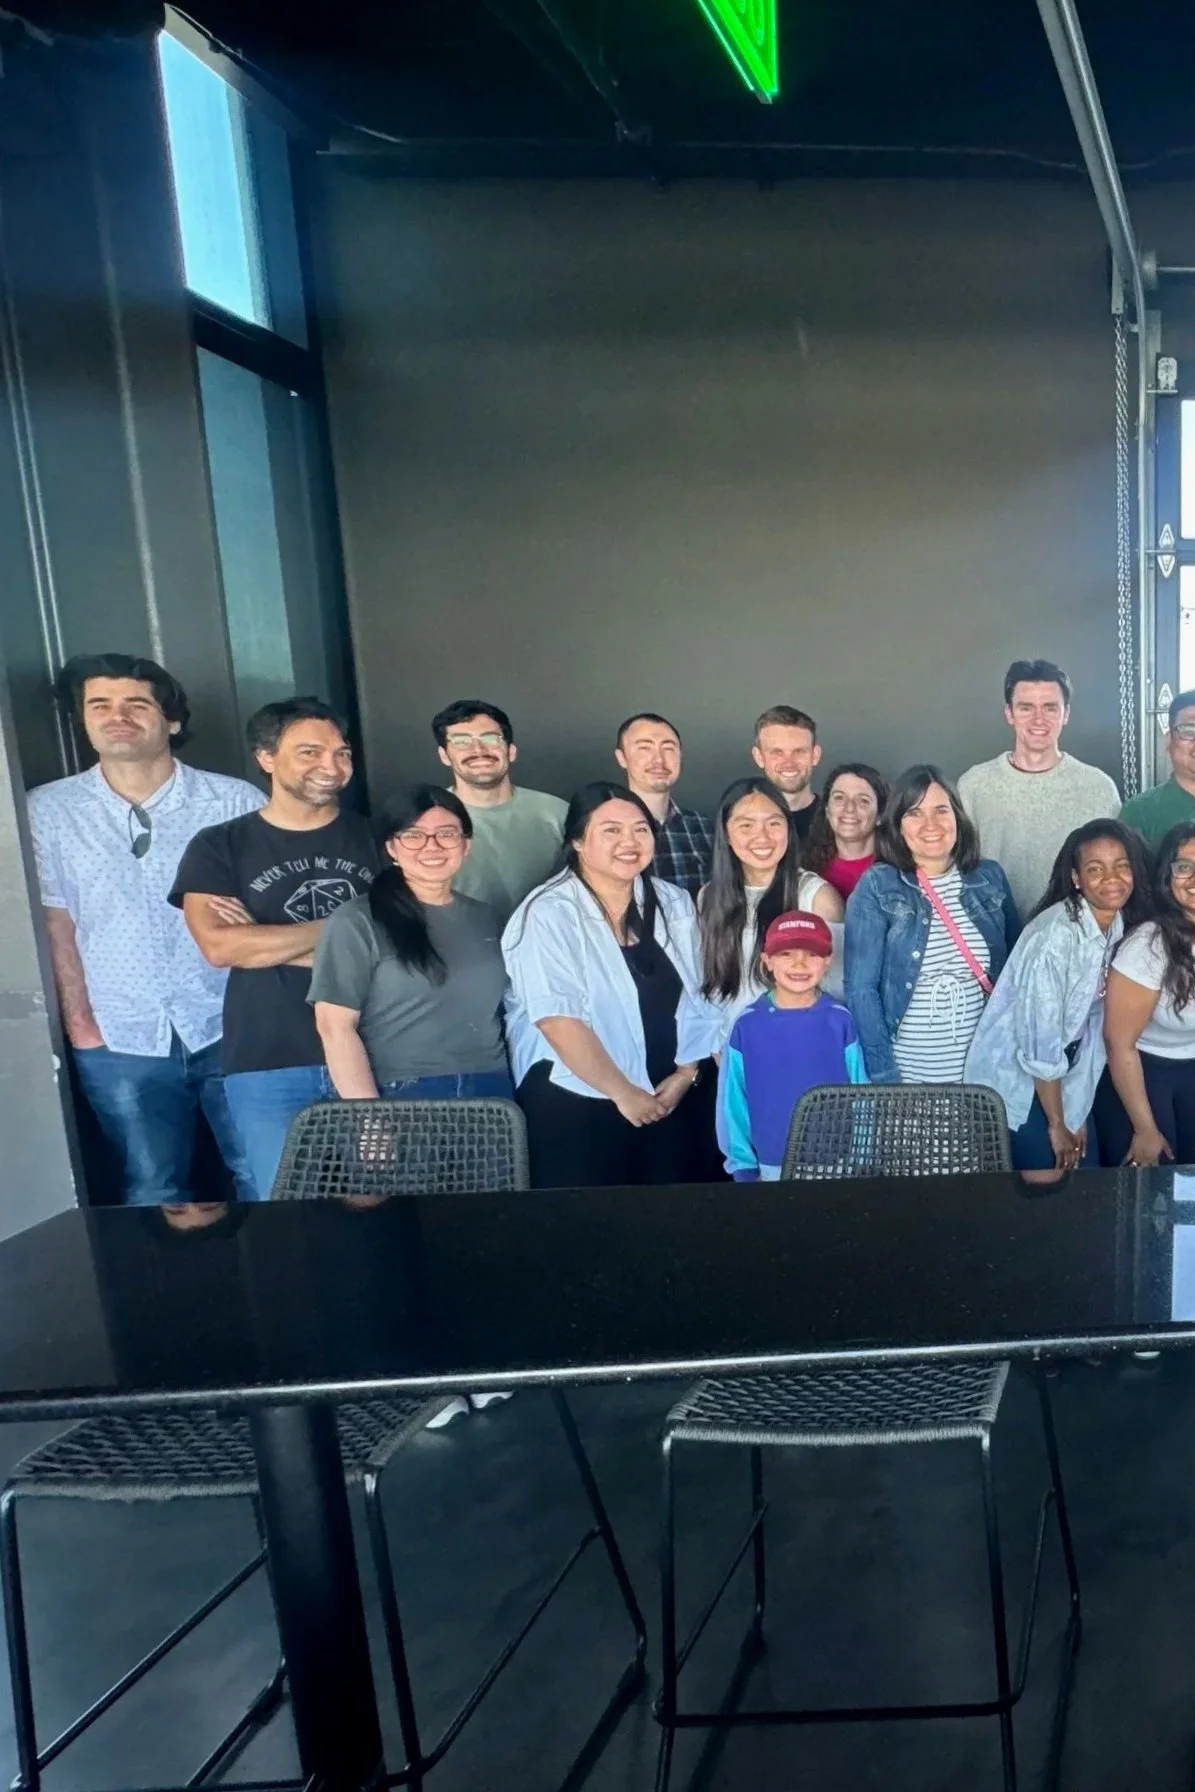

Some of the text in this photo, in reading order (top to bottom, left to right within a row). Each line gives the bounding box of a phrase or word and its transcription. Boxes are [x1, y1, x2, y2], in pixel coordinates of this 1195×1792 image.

[249, 865, 287, 893] NEVER
[284, 858, 310, 873] TELL
[314, 856, 329, 870] ME
[335, 858, 356, 875] THE
[333, 886, 344, 896] 2
